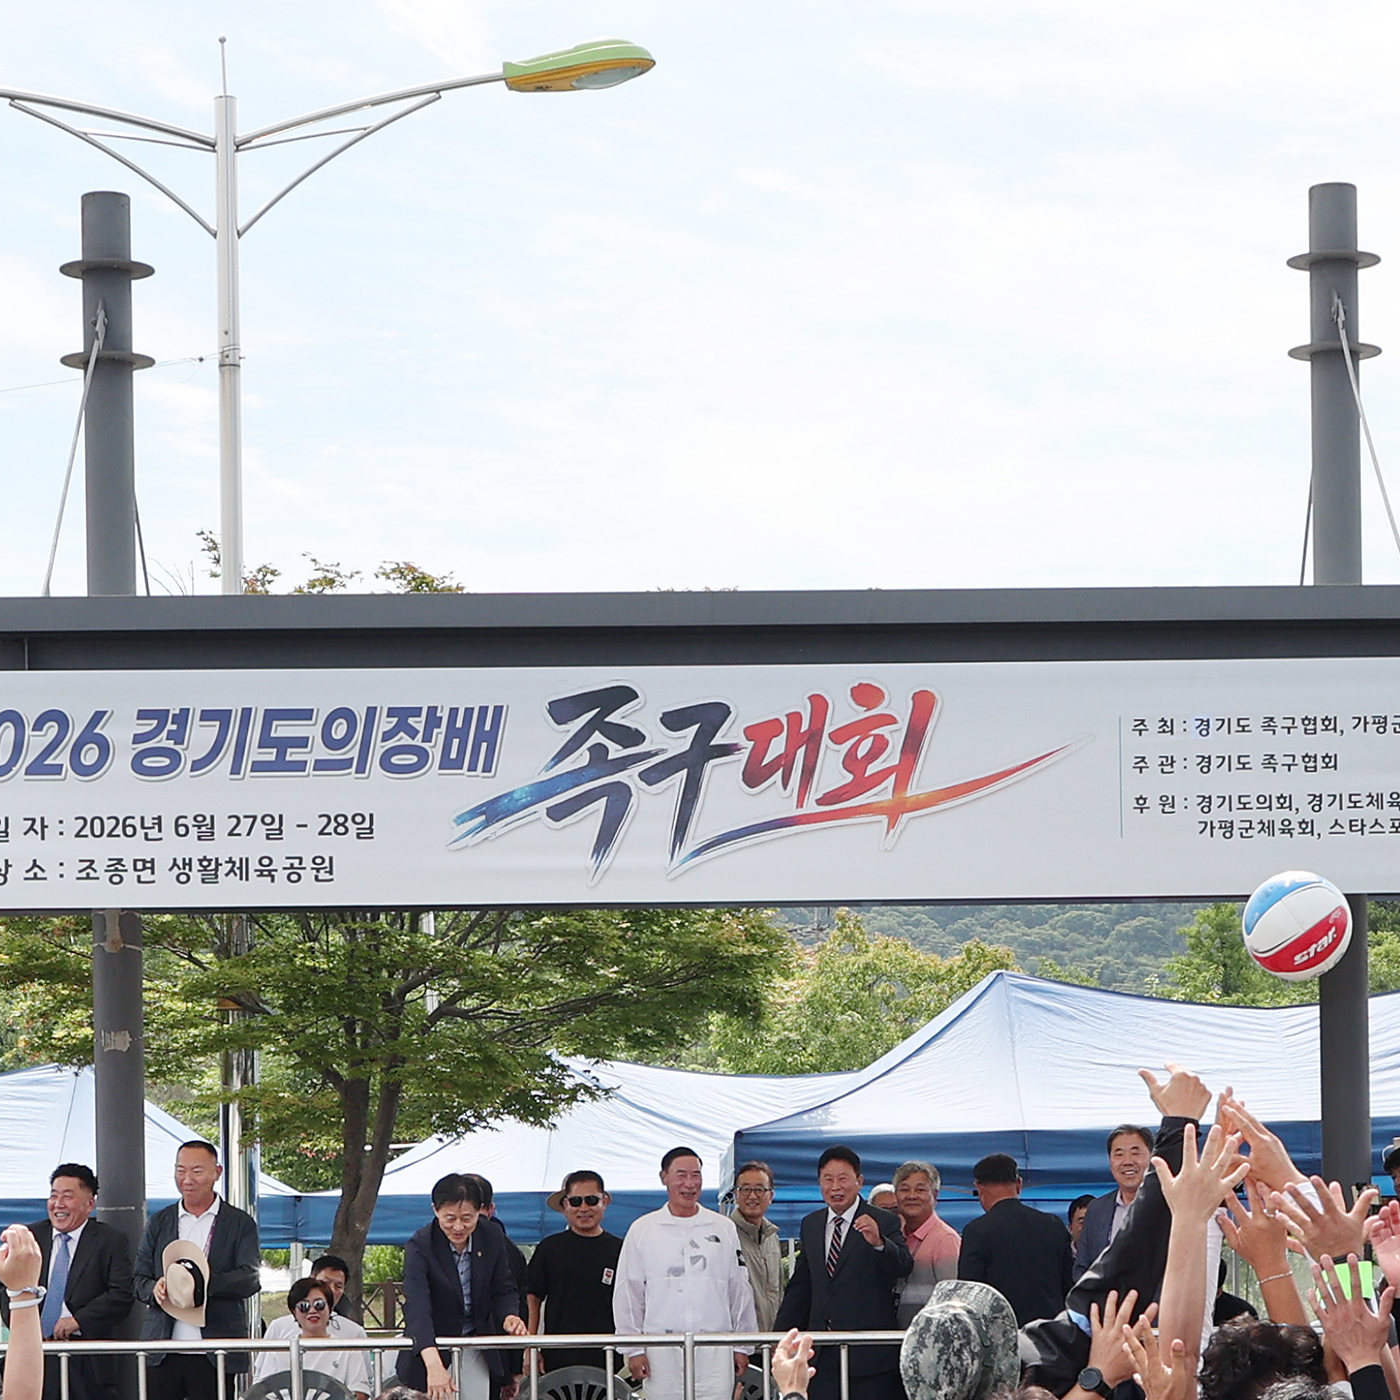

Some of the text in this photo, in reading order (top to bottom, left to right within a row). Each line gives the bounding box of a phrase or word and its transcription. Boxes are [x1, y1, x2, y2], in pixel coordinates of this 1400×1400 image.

[1194, 716, 1253, 737] 경기도
[1260, 714, 1345, 737] 족구협회,
[1195, 754, 1253, 774] 경기도
[1260, 752, 1339, 773] 족구협회
[129, 703, 507, 779] 경기도의장배
[450, 682, 945, 883] 족구대회
[1196, 793, 1300, 814] 경기도의회,
[73, 813, 165, 843] 2026년
[174, 813, 217, 842] 6월
[227, 813, 286, 842] 27일
[317, 812, 377, 842] 28일
[1197, 818, 1323, 840] 가평군체육회,
[74, 856, 158, 886] 조종면
[167, 855, 336, 886] 생활체육공원
